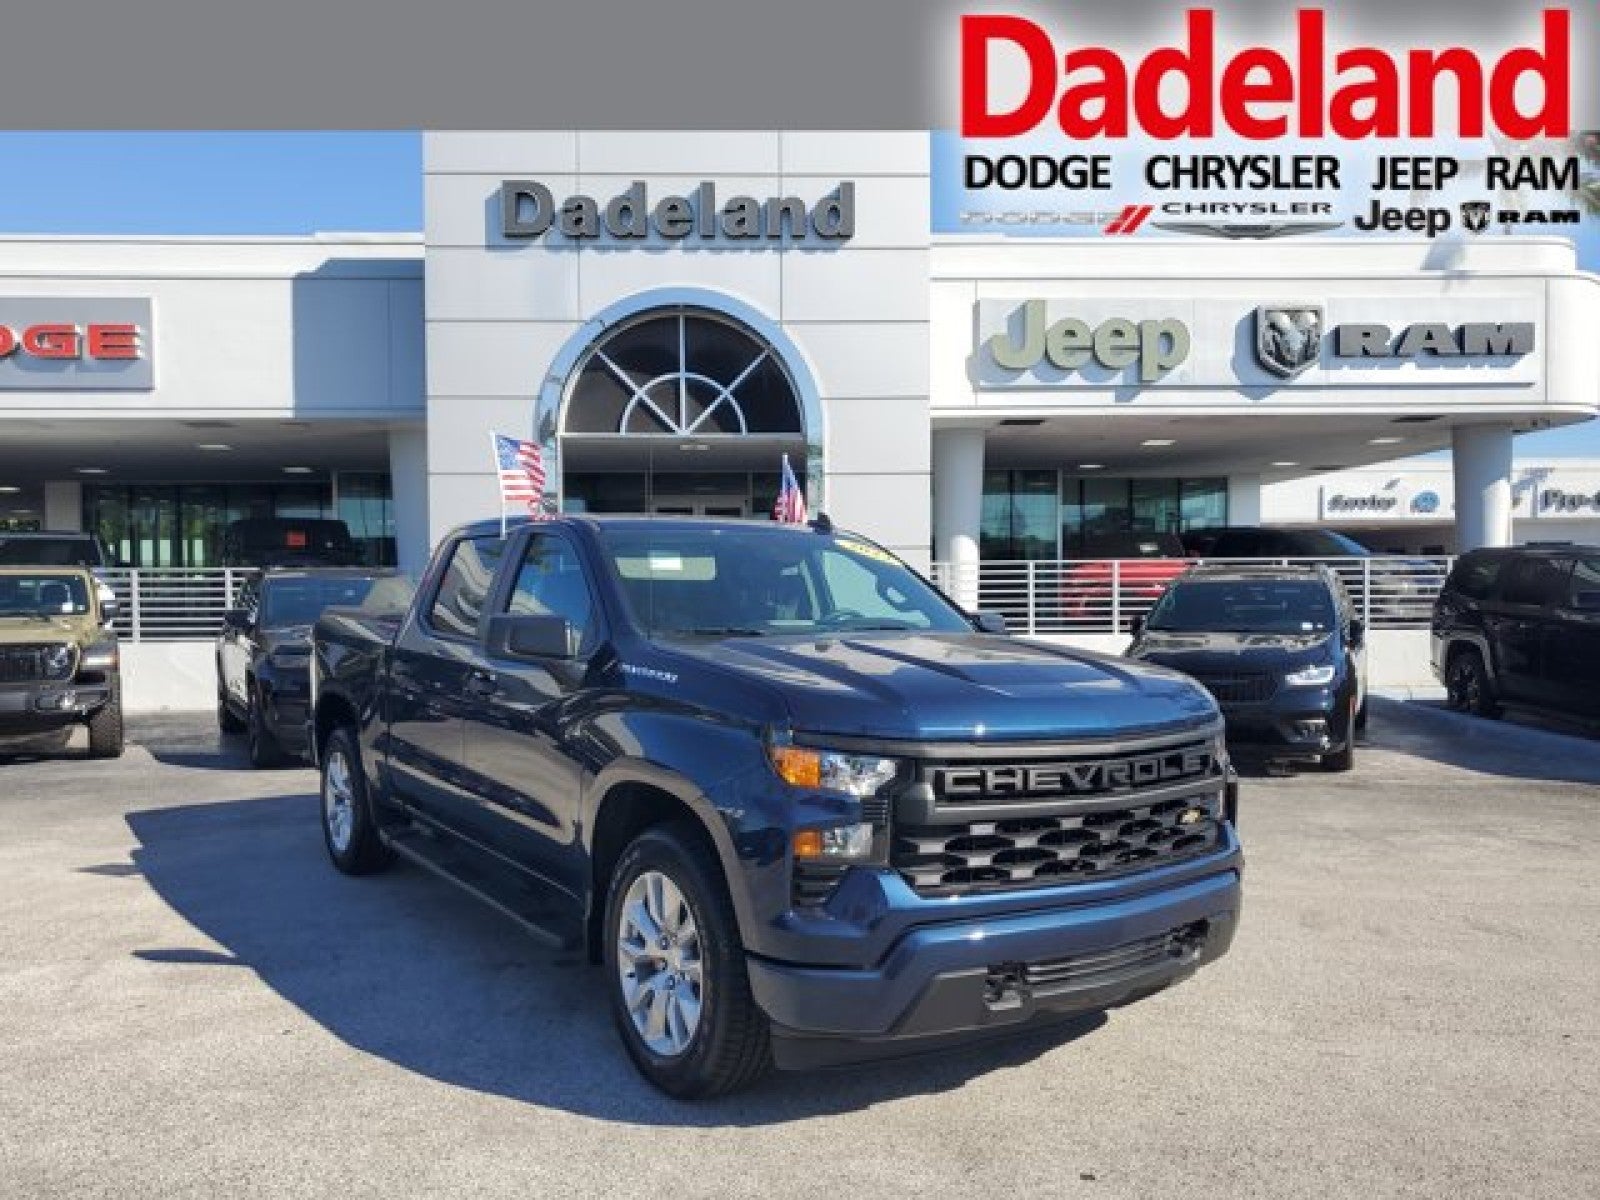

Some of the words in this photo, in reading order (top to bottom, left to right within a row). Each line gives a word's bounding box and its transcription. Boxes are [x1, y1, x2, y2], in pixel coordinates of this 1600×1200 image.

[501, 180, 855, 240] Dadeland
[0, 323, 141, 359] GE
[991, 299, 1190, 382] Jeep
[1336, 322, 1535, 357] RAM
